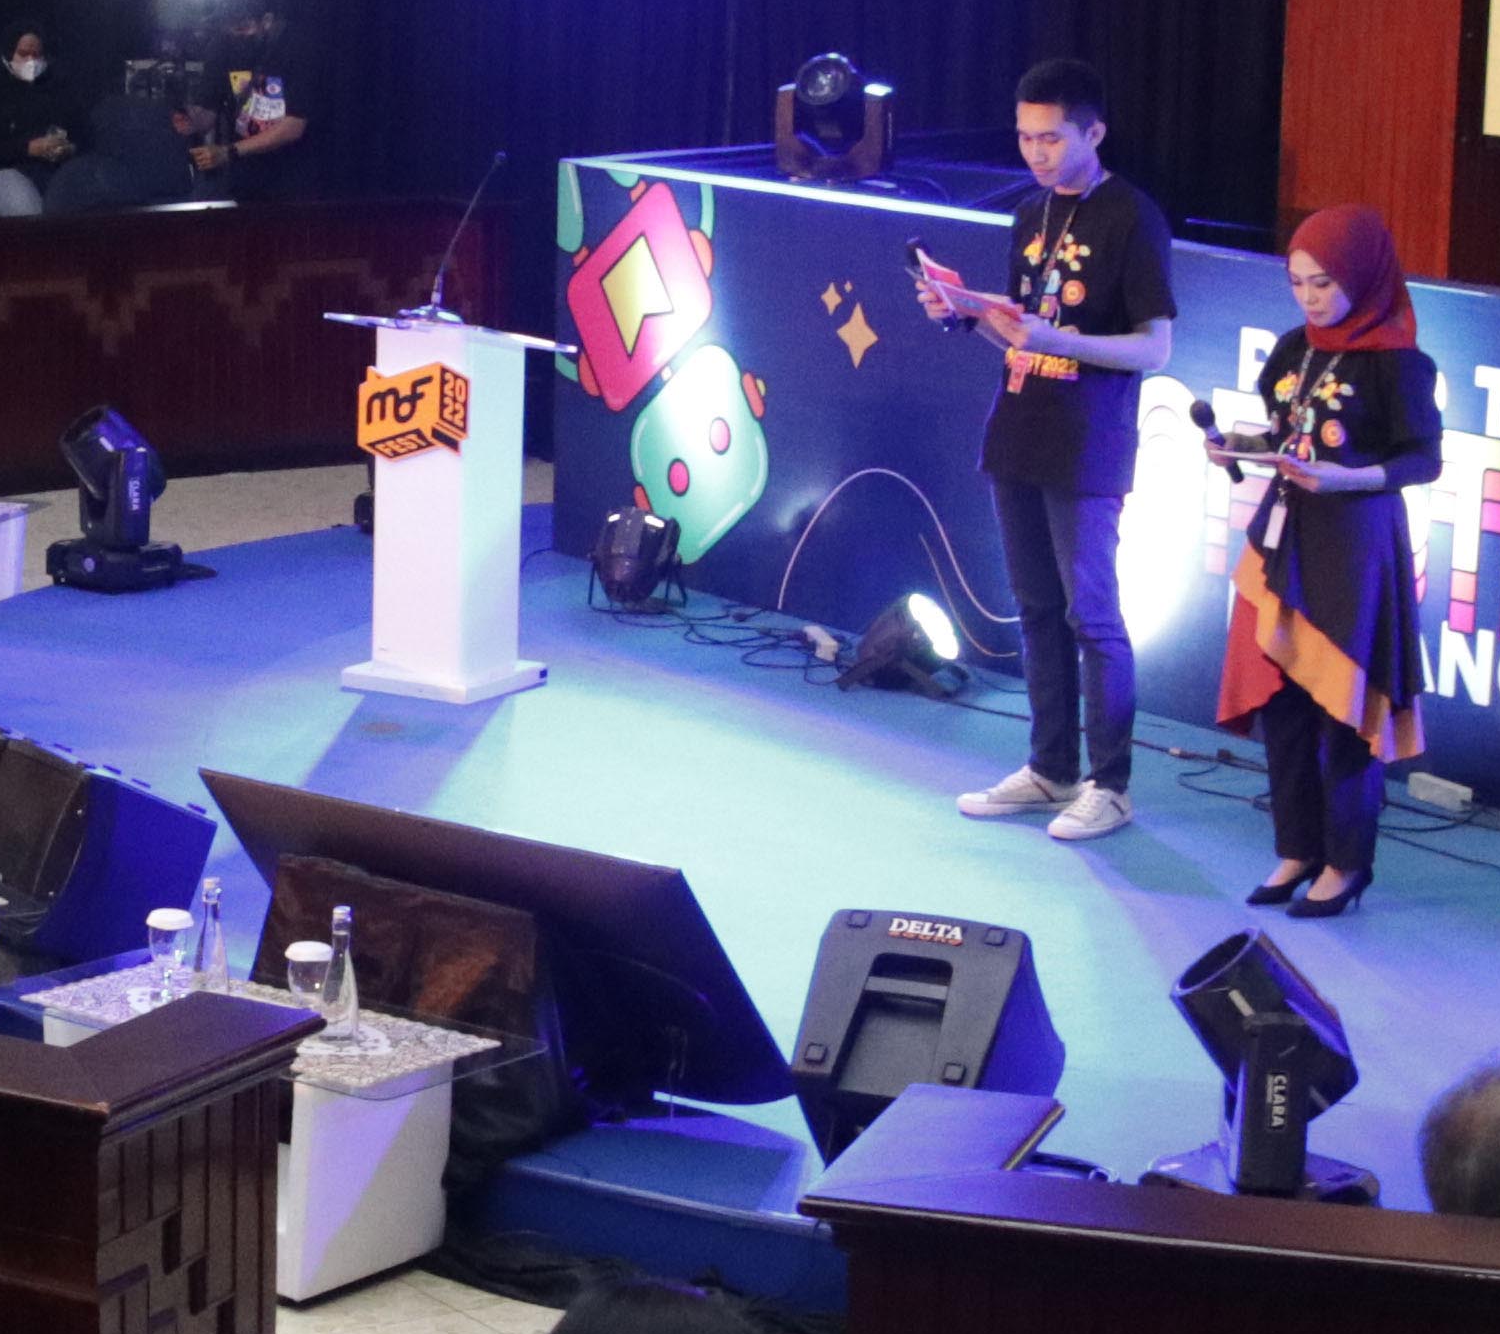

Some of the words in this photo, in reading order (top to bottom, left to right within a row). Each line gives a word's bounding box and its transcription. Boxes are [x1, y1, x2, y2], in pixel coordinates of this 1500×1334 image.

[373, 432, 429, 458] FEST
[888, 917, 964, 941] DELTA
[1271, 1073, 1288, 1127] CLARA
